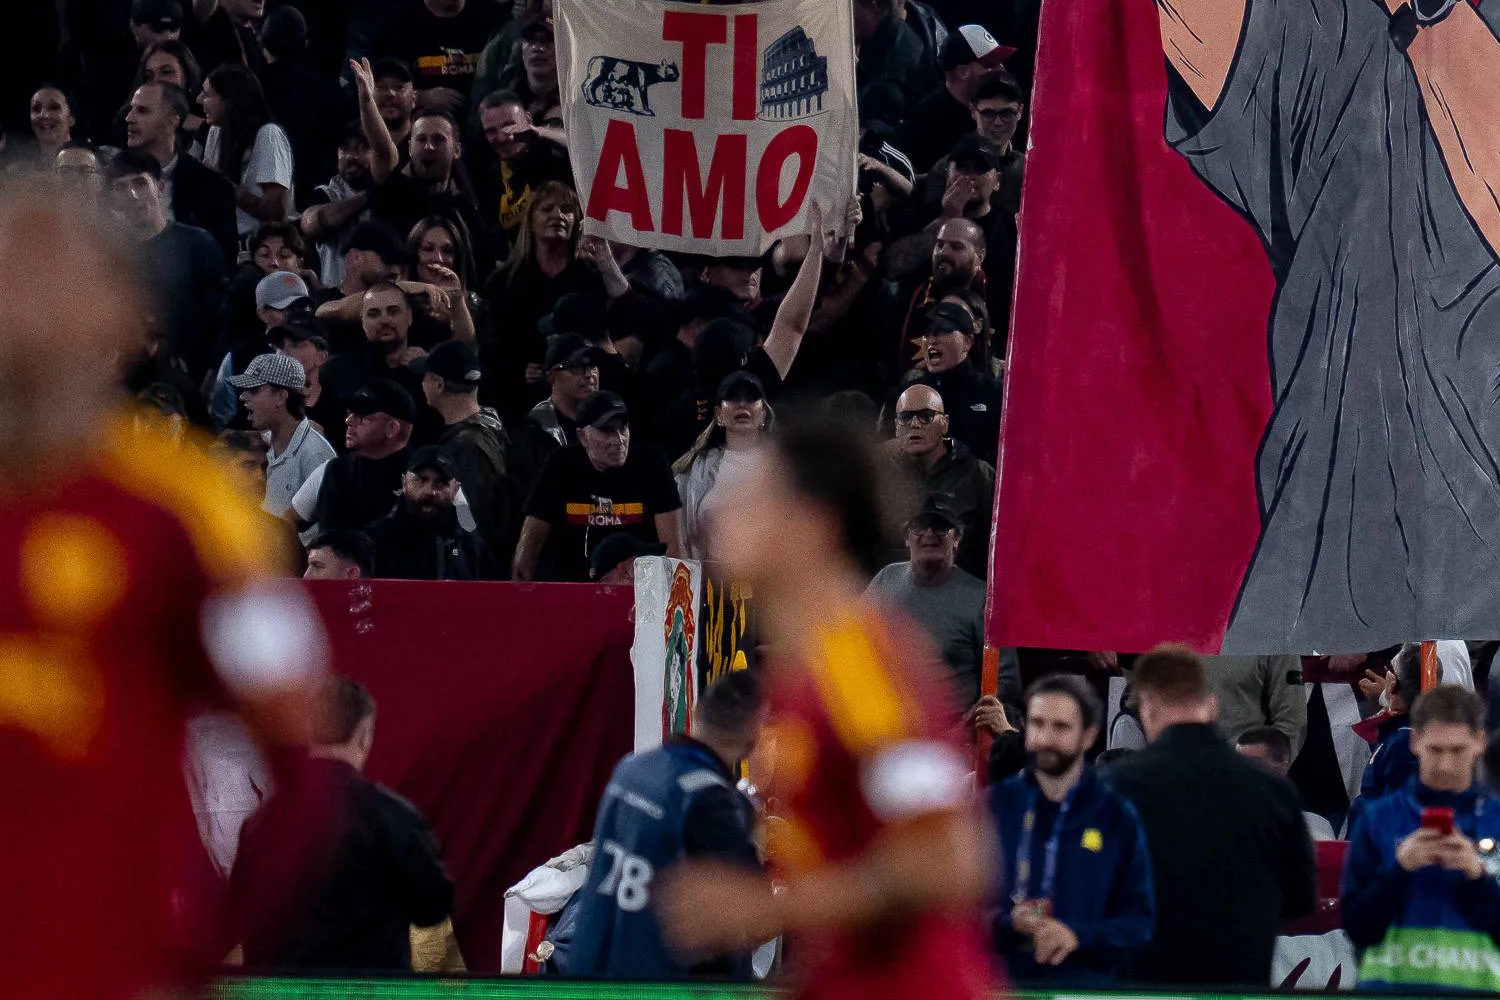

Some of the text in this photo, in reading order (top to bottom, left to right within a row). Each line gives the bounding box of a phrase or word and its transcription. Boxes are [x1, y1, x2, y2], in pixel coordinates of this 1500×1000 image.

[662, 10, 758, 121] TI
[586, 118, 818, 240] AMO
[587, 514, 623, 526] ROMA
[597, 838, 656, 912] 78
